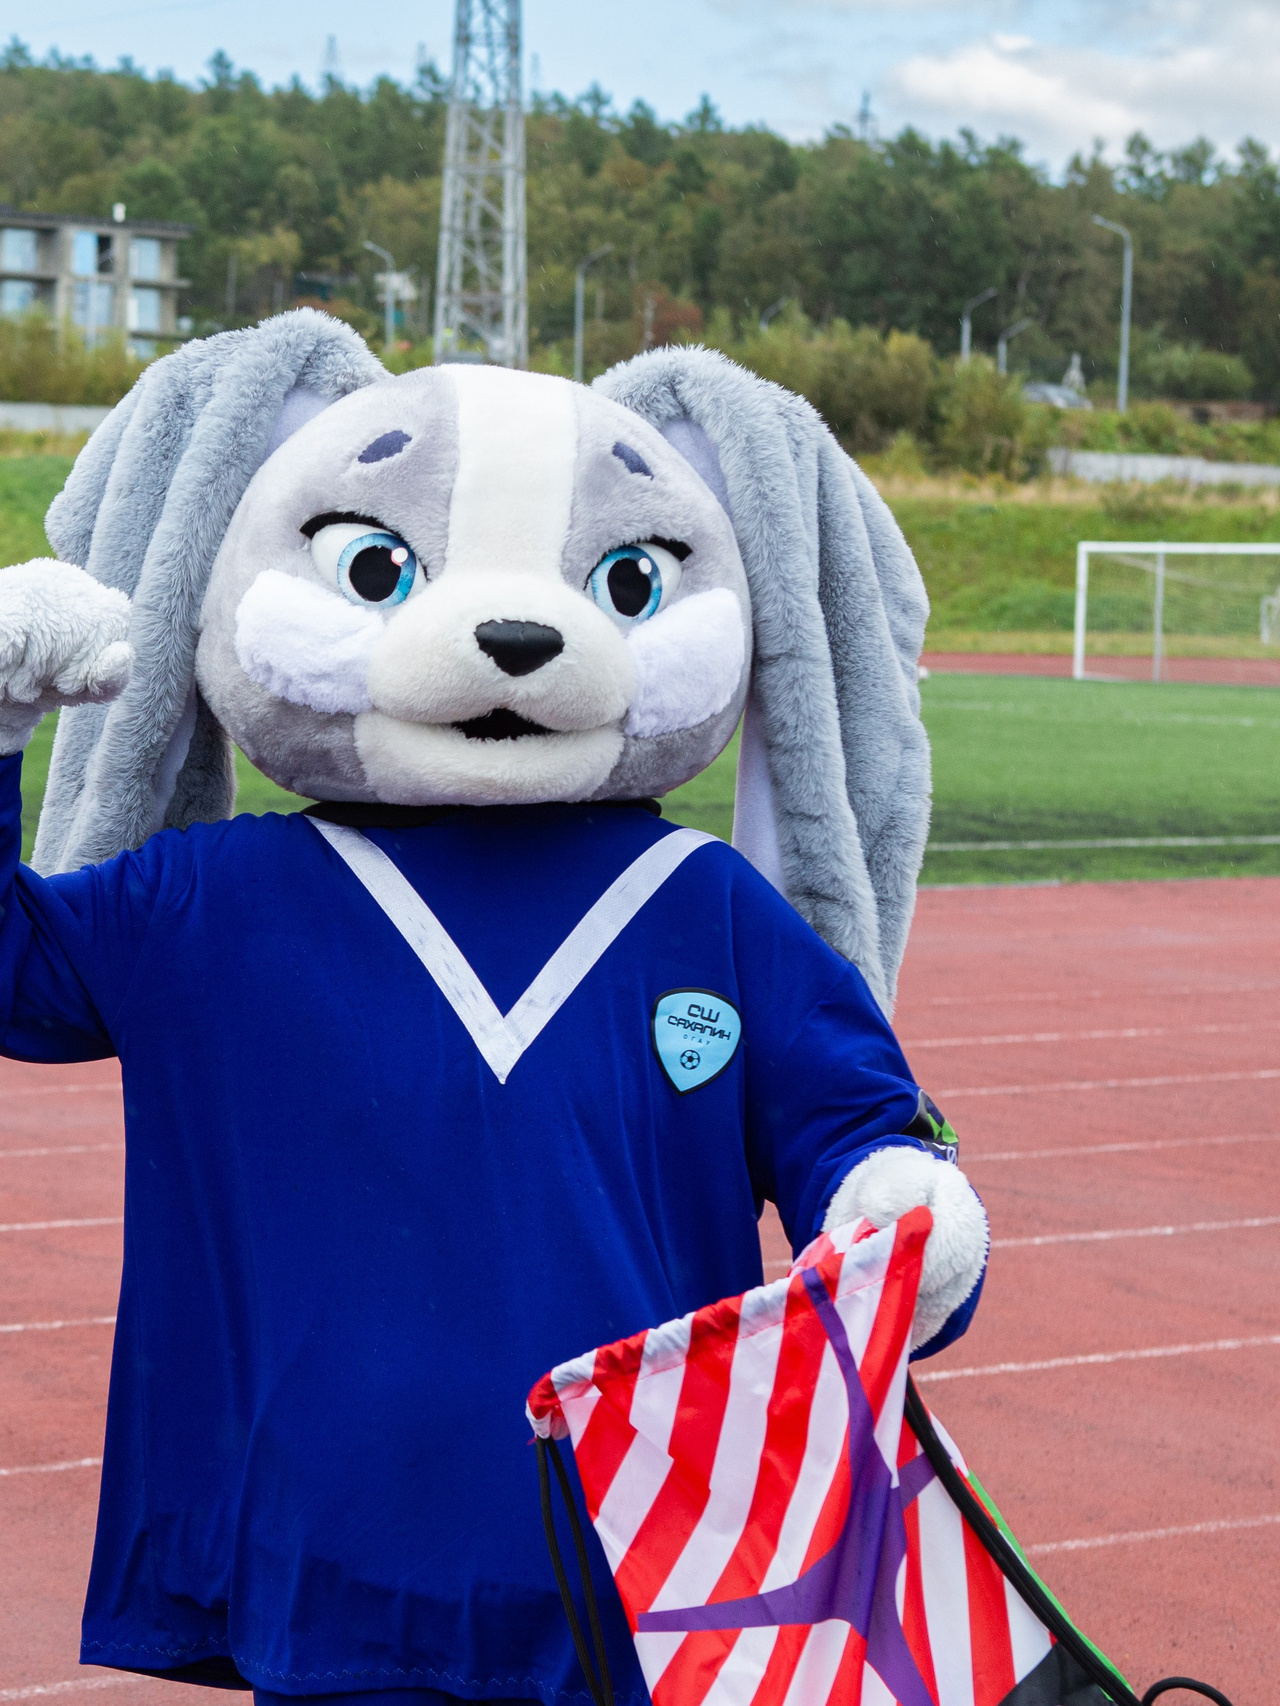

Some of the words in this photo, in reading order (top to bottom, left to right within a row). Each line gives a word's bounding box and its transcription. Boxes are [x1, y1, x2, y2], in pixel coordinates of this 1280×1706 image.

[687, 1004, 720, 1023] СШ
[667, 1015, 731, 1040] САХАЛИН
[683, 1034, 711, 1045] ОГАУ
